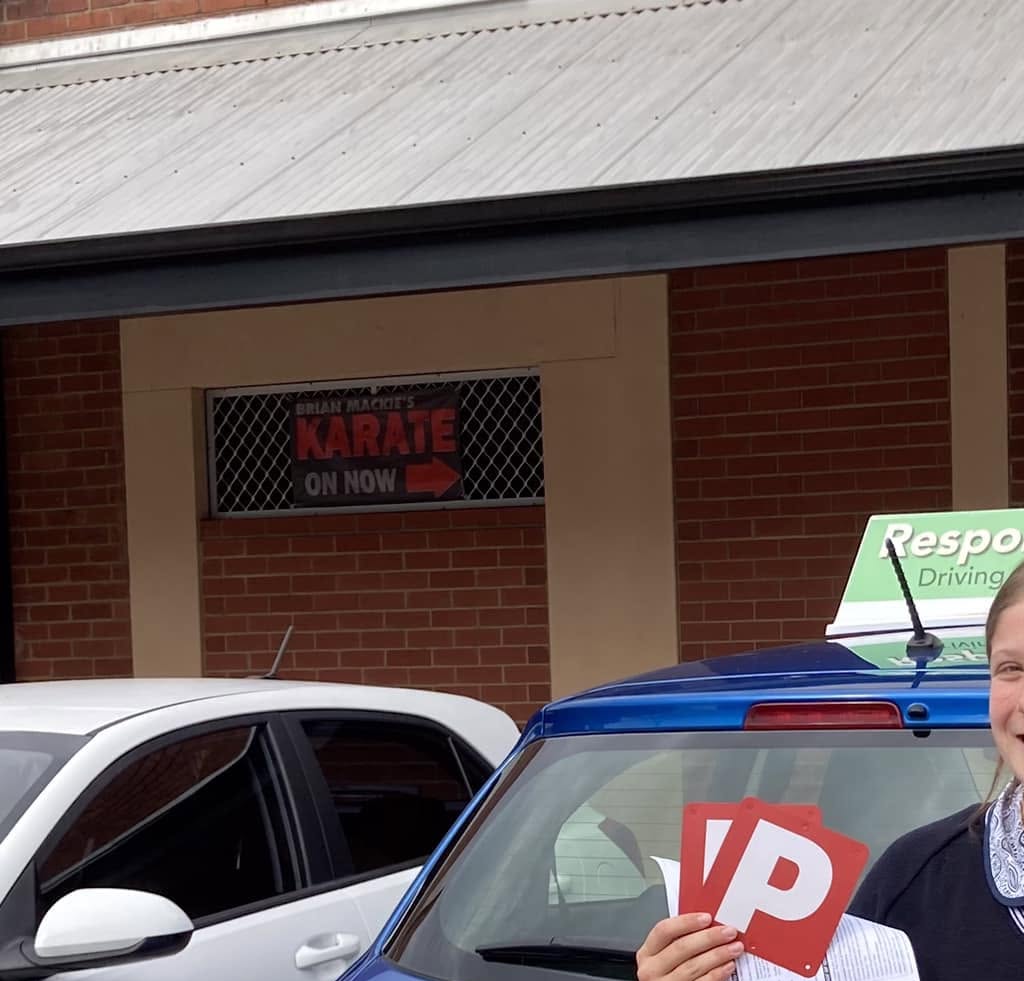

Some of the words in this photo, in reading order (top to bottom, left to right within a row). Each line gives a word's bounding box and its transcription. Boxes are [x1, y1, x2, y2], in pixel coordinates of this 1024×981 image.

[295, 400, 342, 416] BRIAN
[296, 408, 457, 460] KARATE
[304, 471, 338, 496] ON
[344, 468, 397, 494] NOW
[917, 566, 1004, 590] Driving
[713, 818, 833, 934] P
